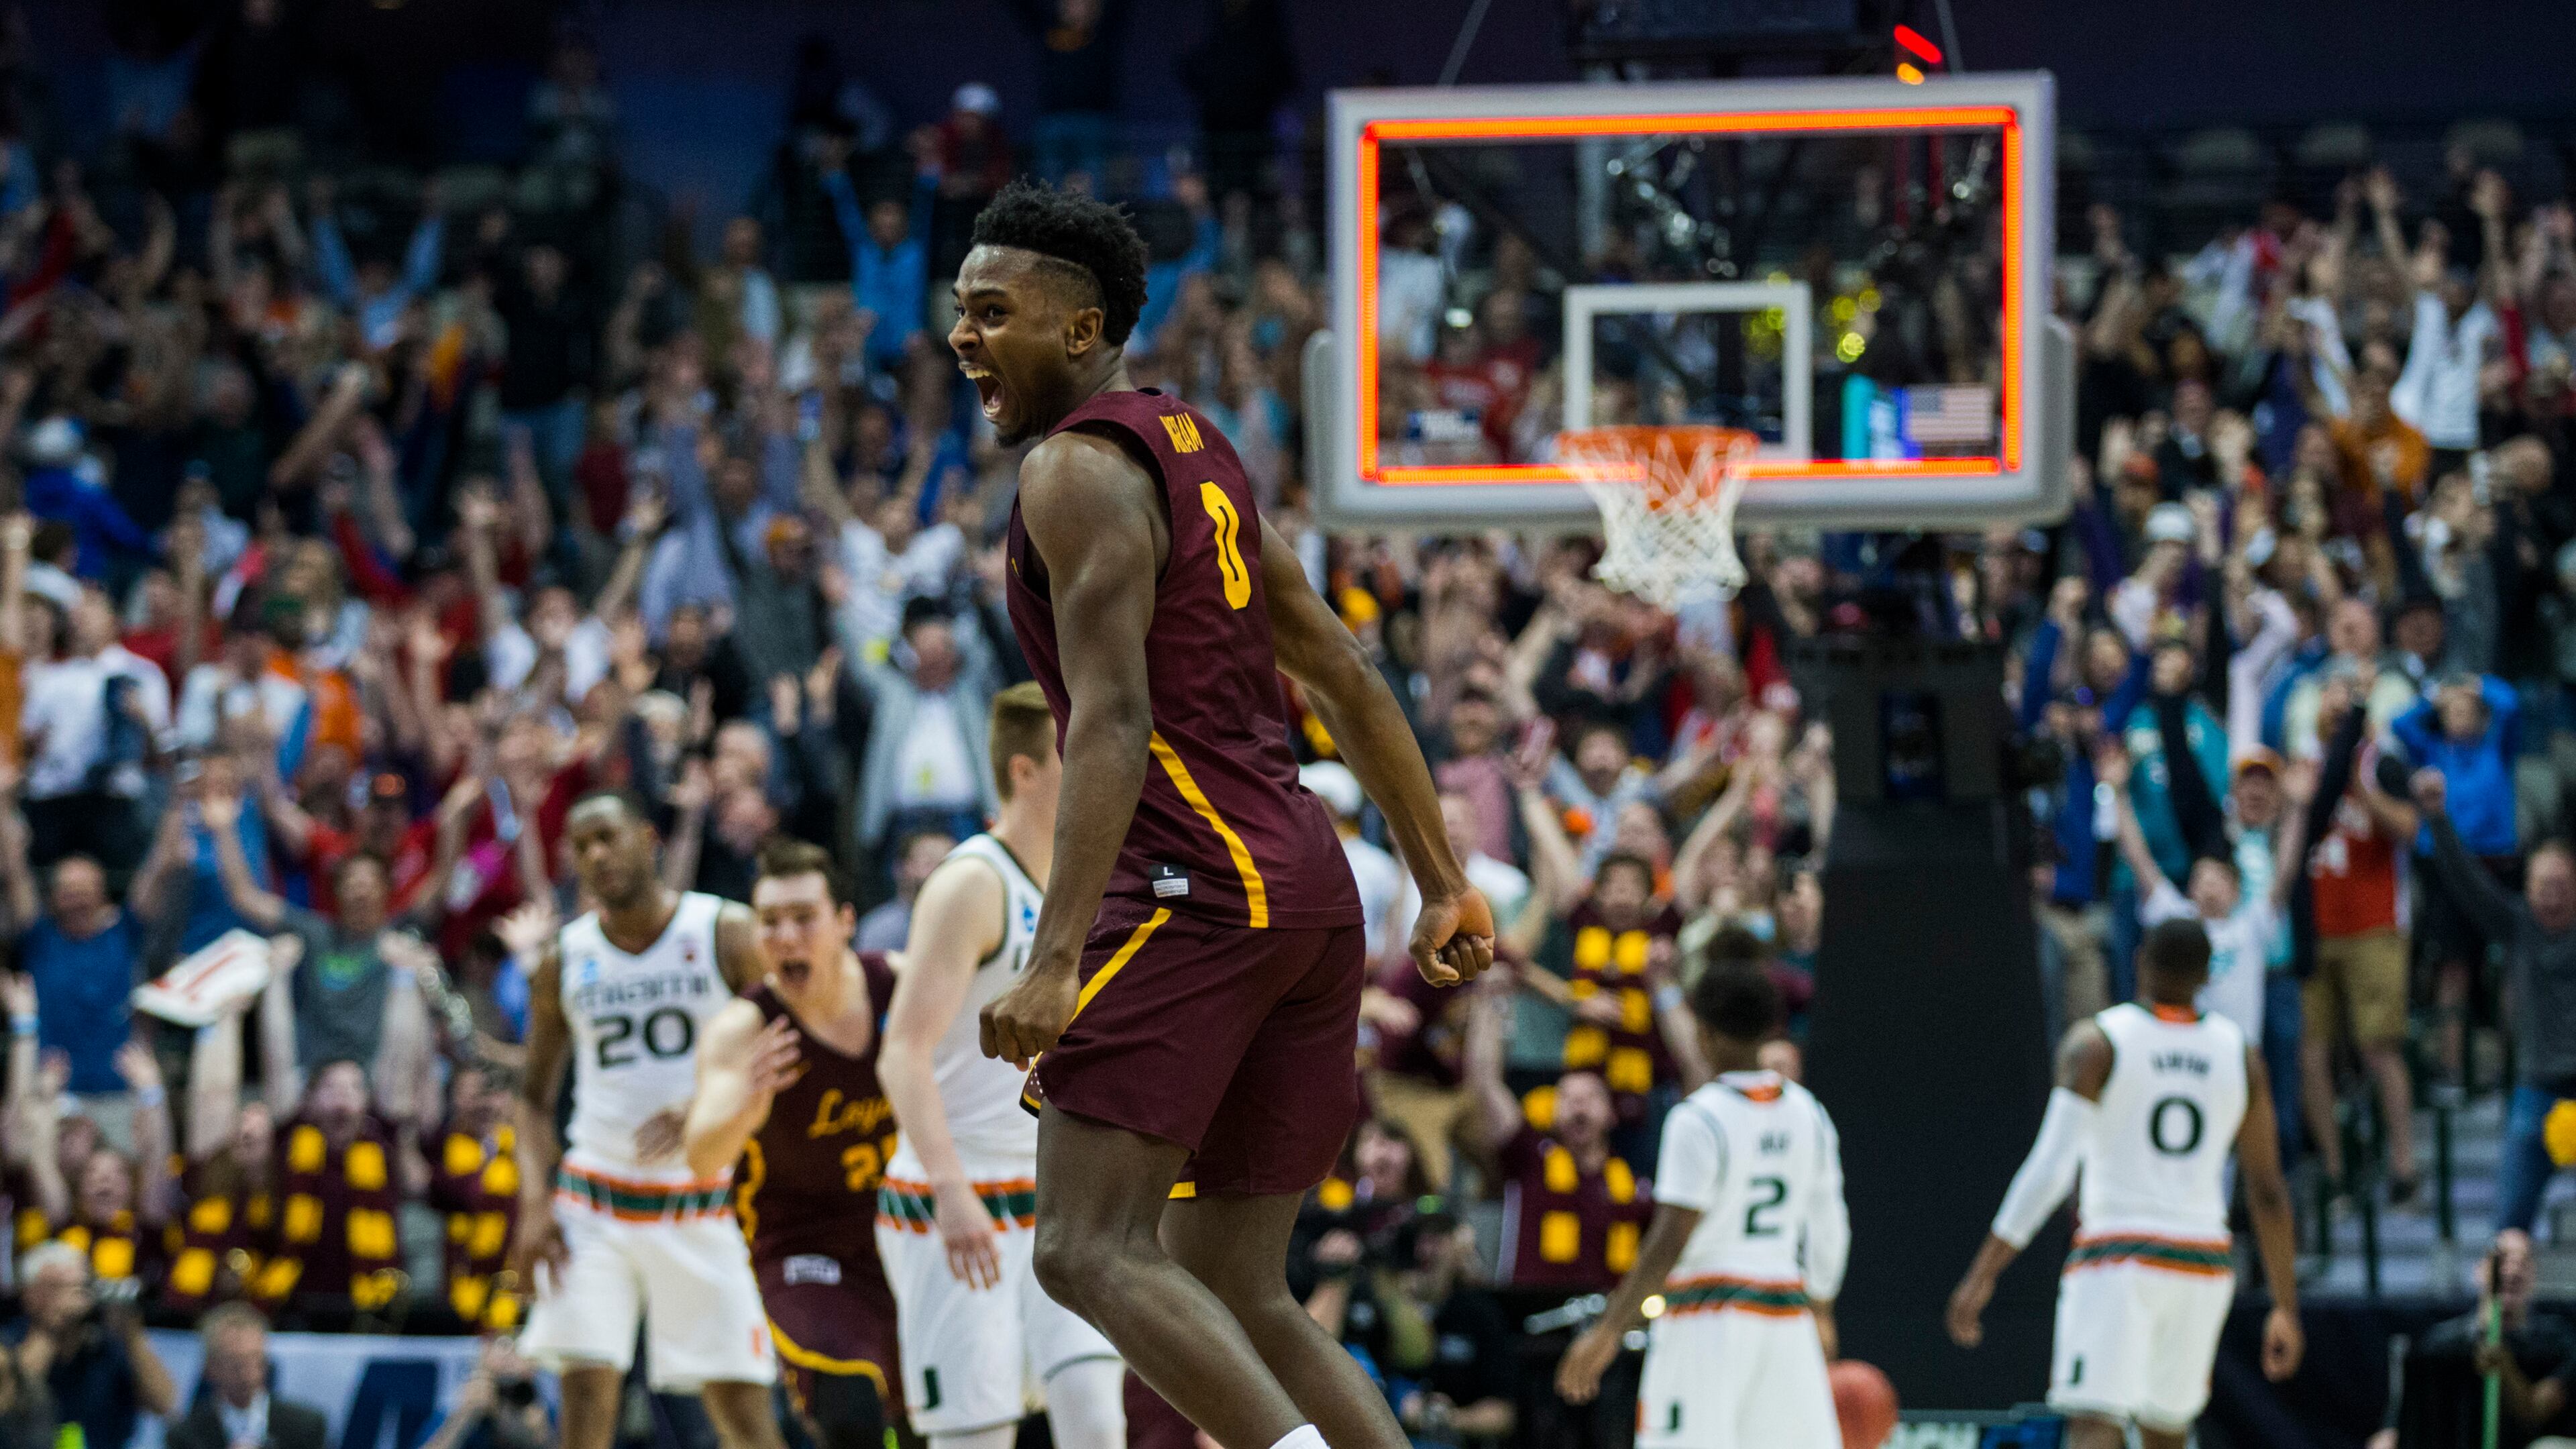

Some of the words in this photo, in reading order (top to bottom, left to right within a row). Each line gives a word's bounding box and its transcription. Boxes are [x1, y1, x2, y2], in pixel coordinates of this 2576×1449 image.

[1199, 480, 1252, 610] 0
[1163, 866, 1174, 876] L
[592, 1008, 696, 1069] 20
[2149, 1095, 2205, 1157] 0
[1744, 1175, 1788, 1238] 2
